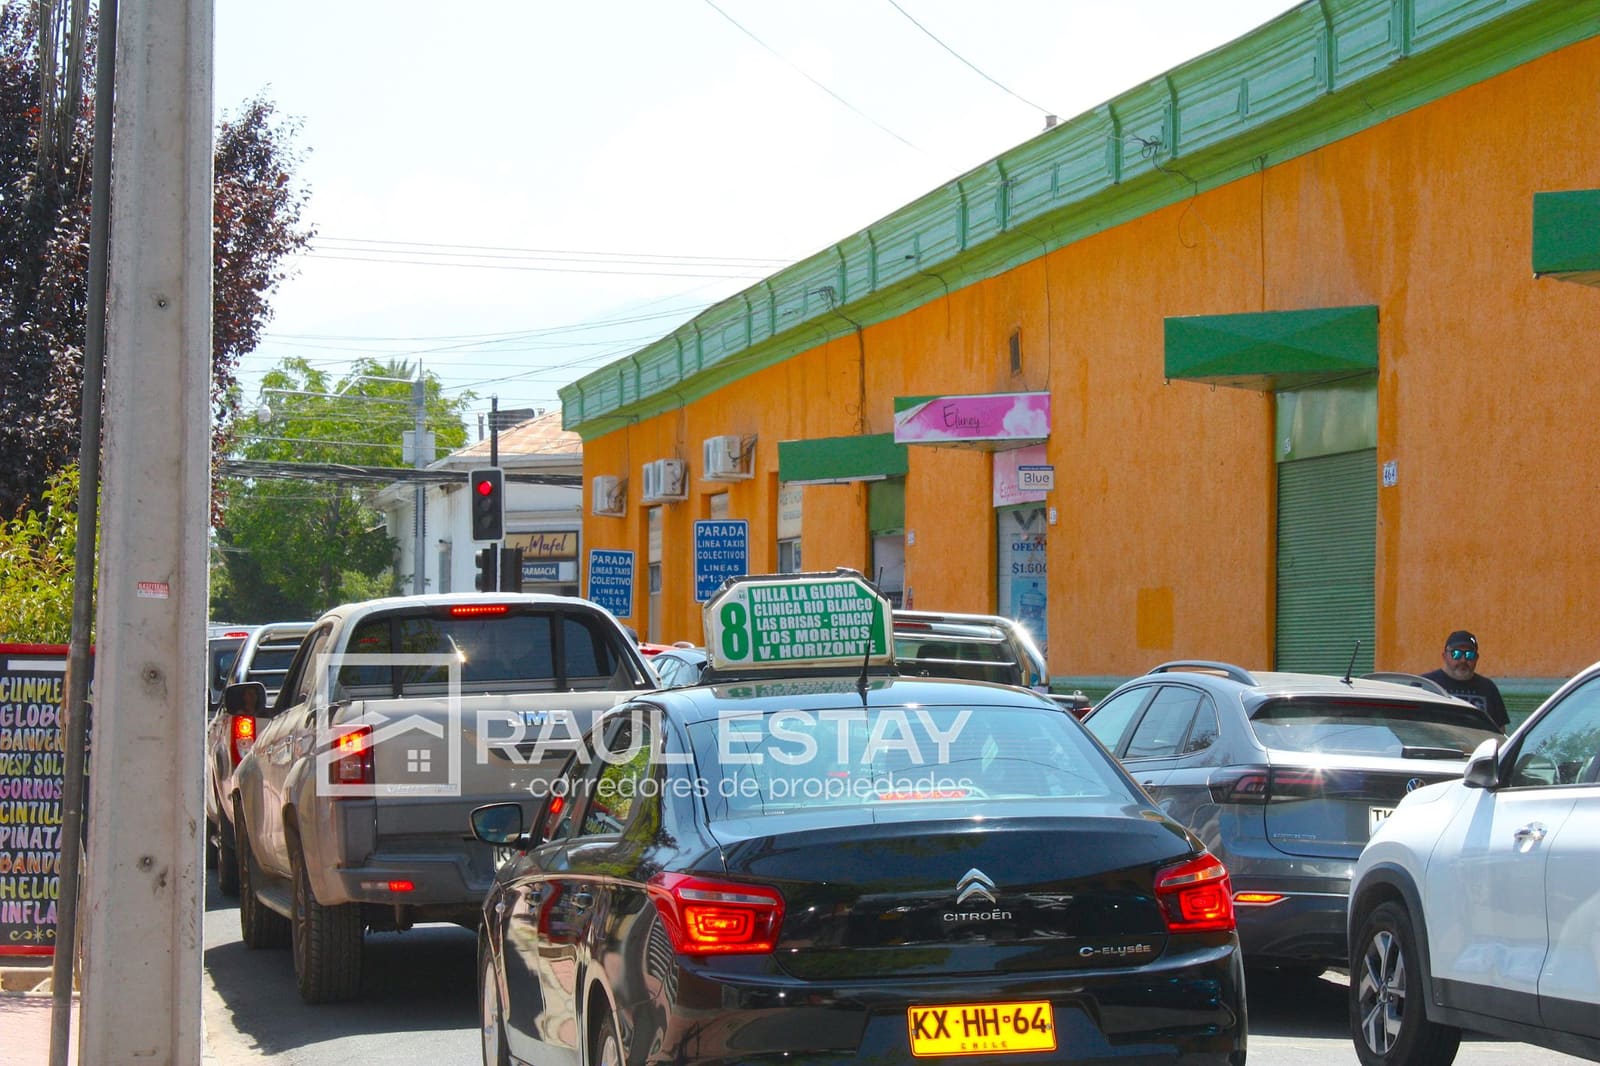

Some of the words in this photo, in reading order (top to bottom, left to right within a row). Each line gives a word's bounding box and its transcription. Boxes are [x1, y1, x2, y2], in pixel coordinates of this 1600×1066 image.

[1024, 473, 1050, 483] Blue
[697, 525, 745, 537] PARADA
[697, 540, 721, 548] LINEA
[723, 540, 745, 548] TAXIS
[592, 554, 632, 566] PARADA
[697, 550, 745, 560] COLECTIVOS
[703, 564, 740, 572] LINEAS
[591, 576, 631, 586] COLECTIVO
[752, 586, 789, 603] VILLA
[791, 586, 808, 601] LA
[809, 583, 858, 600] GLORIA
[754, 601, 802, 617] CLINICA
[804, 600, 824, 614] RIO
[827, 598, 873, 613] BLANCO
[756, 617, 777, 631] LAS
[780, 614, 821, 630] BRISAS
[830, 611, 874, 627] CHACAY
[720, 602, 749, 661] 8
[762, 630, 790, 645] LOS
[795, 626, 870, 643] MORENOS
[759, 646, 775, 660] V.
[780, 640, 876, 658] HORIZONTE
